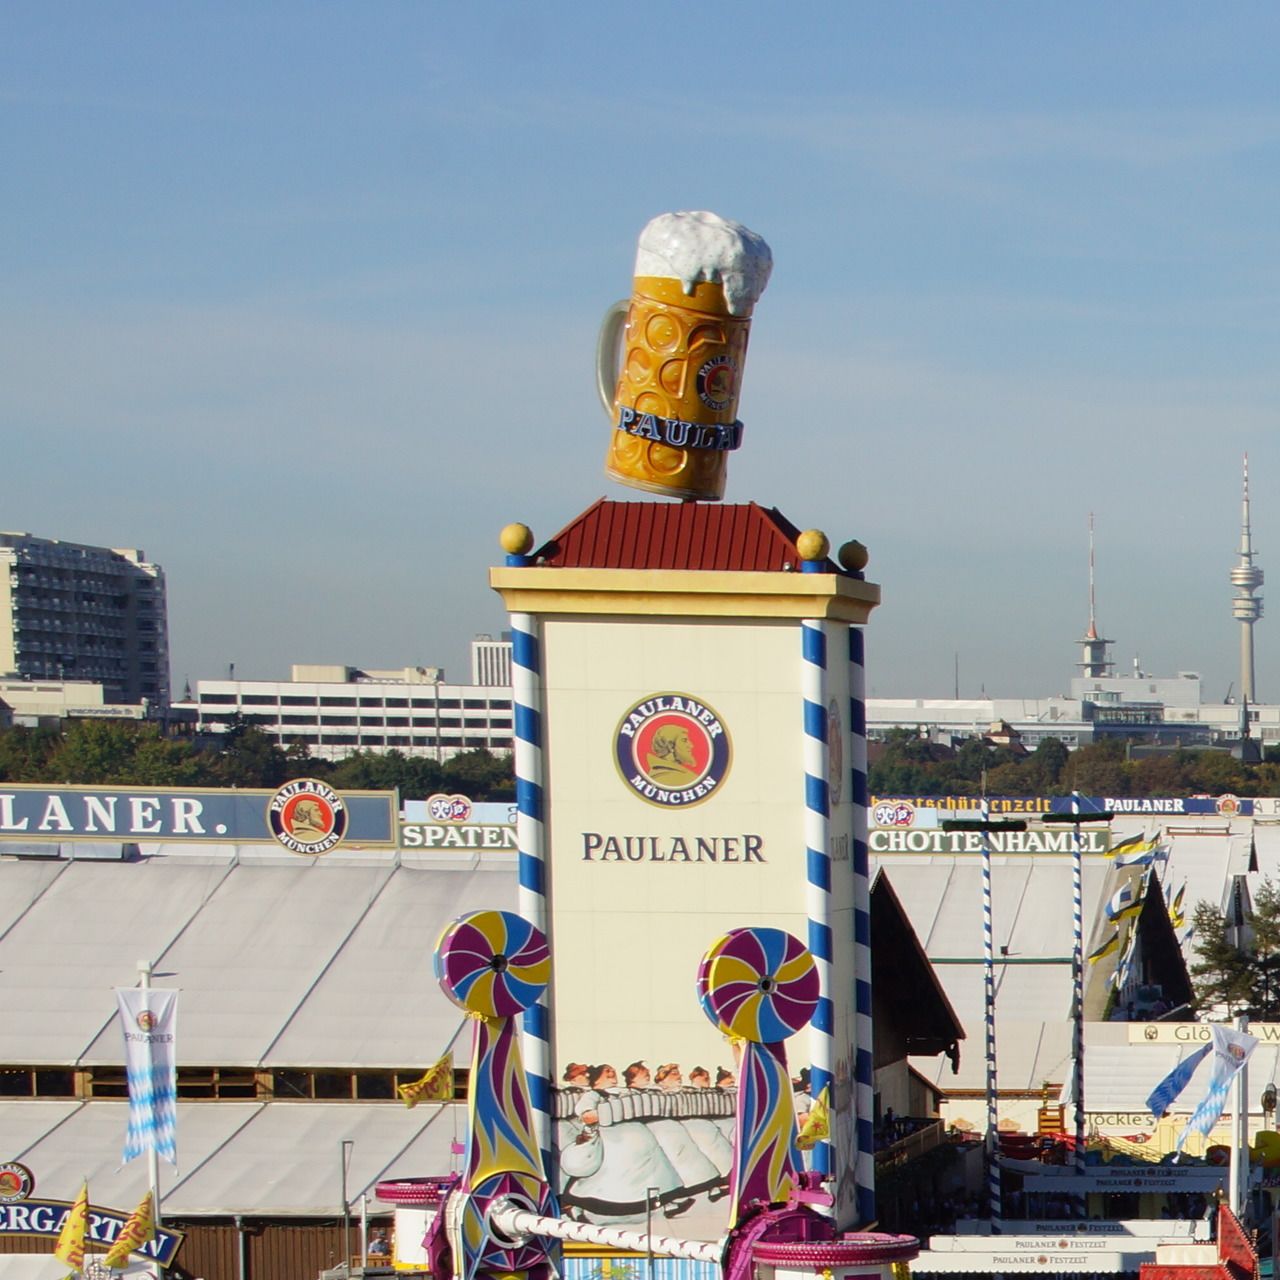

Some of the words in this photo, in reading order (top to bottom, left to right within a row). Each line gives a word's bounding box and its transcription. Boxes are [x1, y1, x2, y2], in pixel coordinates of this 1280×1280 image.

[620, 693, 724, 738] PAULANER
[271, 780, 344, 814] PAULANER
[629, 774, 719, 807] MÜNCHEN
[1104, 797, 1184, 813] PAULANER
[276, 832, 341, 856] MÜNCHEN
[581, 832, 767, 863] PAULANER
[123, 1032, 174, 1044] PAULANER
[1096, 1179, 1132, 1187] PAULANER
[1036, 1224, 1077, 1232] PAULANER
[1088, 1223, 1125, 1232] FESTZELT
[1015, 1240, 1057, 1249] PAULANER
[1070, 1240, 1107, 1249] FESTZELT
[992, 1256, 1036, 1265] PAULANER
[1049, 1256, 1089, 1265] FESTZELT
